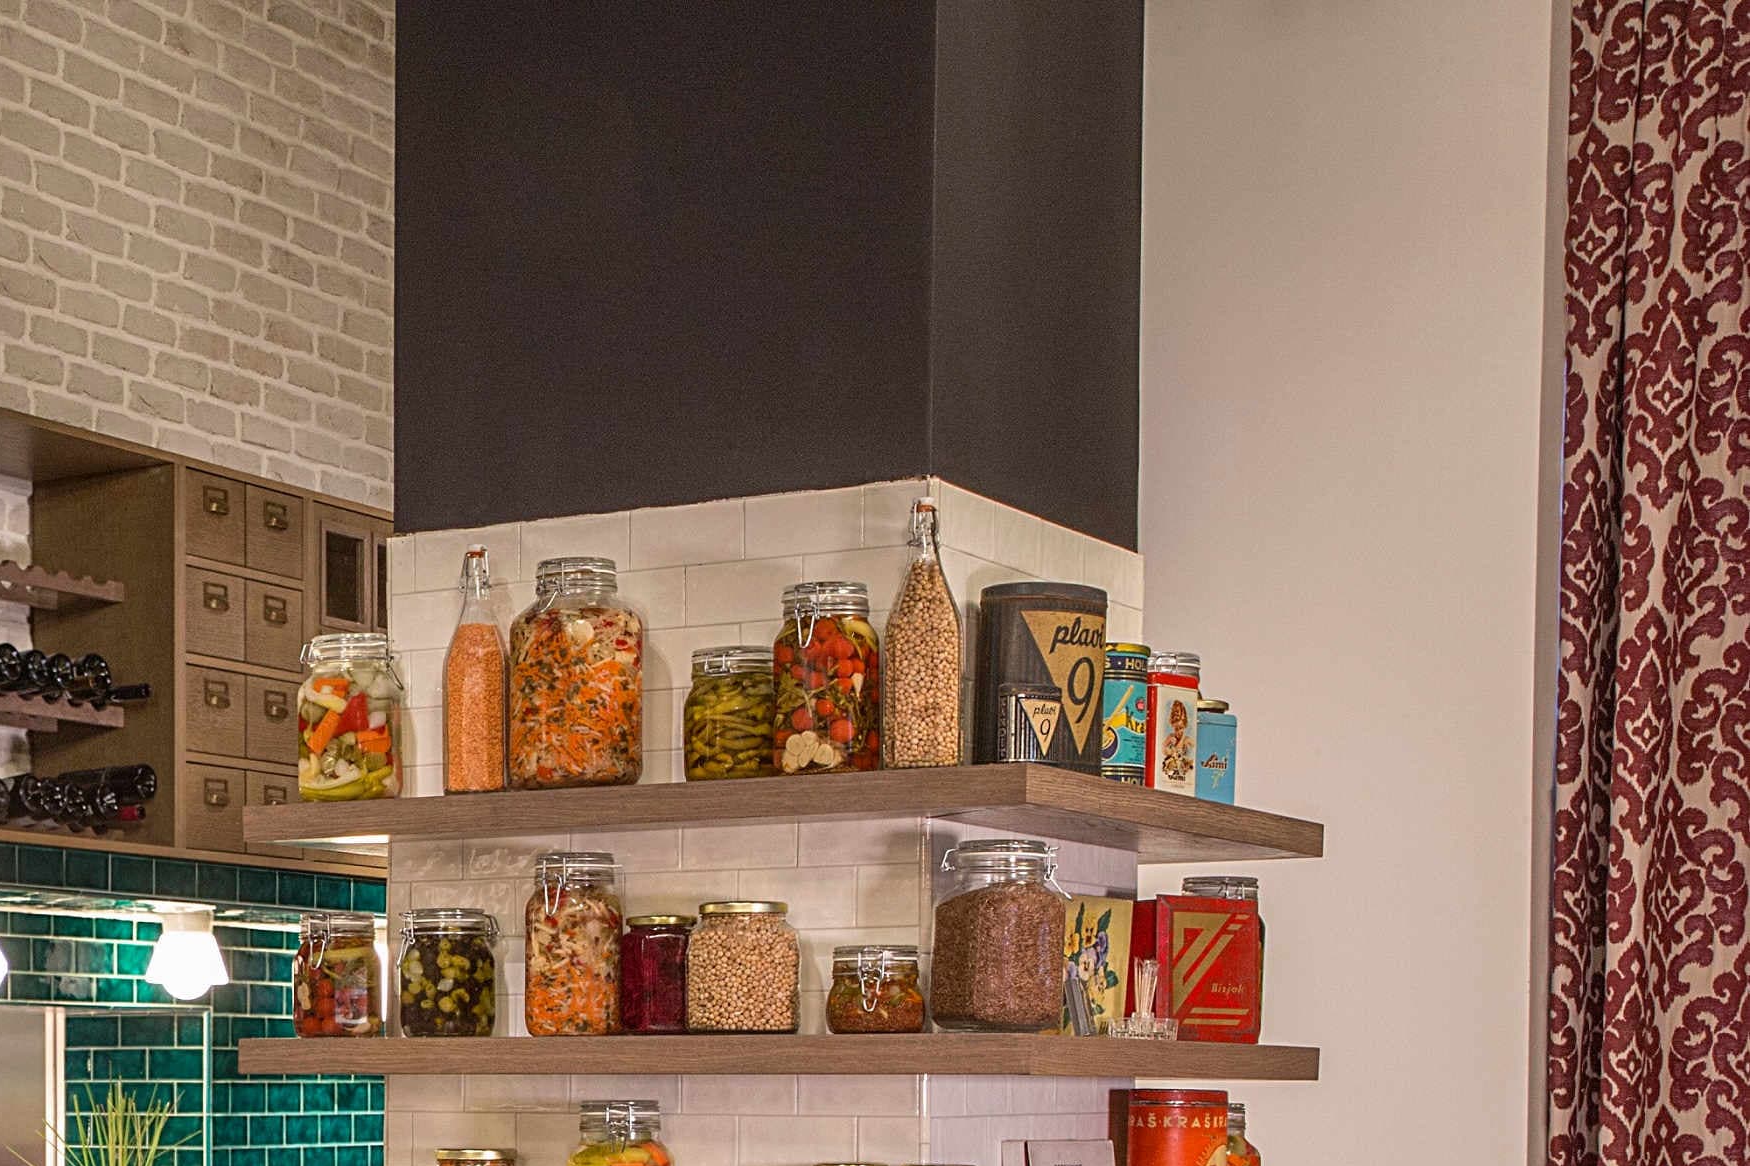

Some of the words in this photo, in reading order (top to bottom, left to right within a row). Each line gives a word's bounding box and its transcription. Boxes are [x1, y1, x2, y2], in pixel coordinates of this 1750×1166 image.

[1050, 616, 1105, 654] plavi
[1068, 656, 1096, 725] 9
[1033, 704, 1056, 718] plavi
[1040, 718, 1051, 743] 9
[1163, 1112, 1211, 1129] KRAŠ
